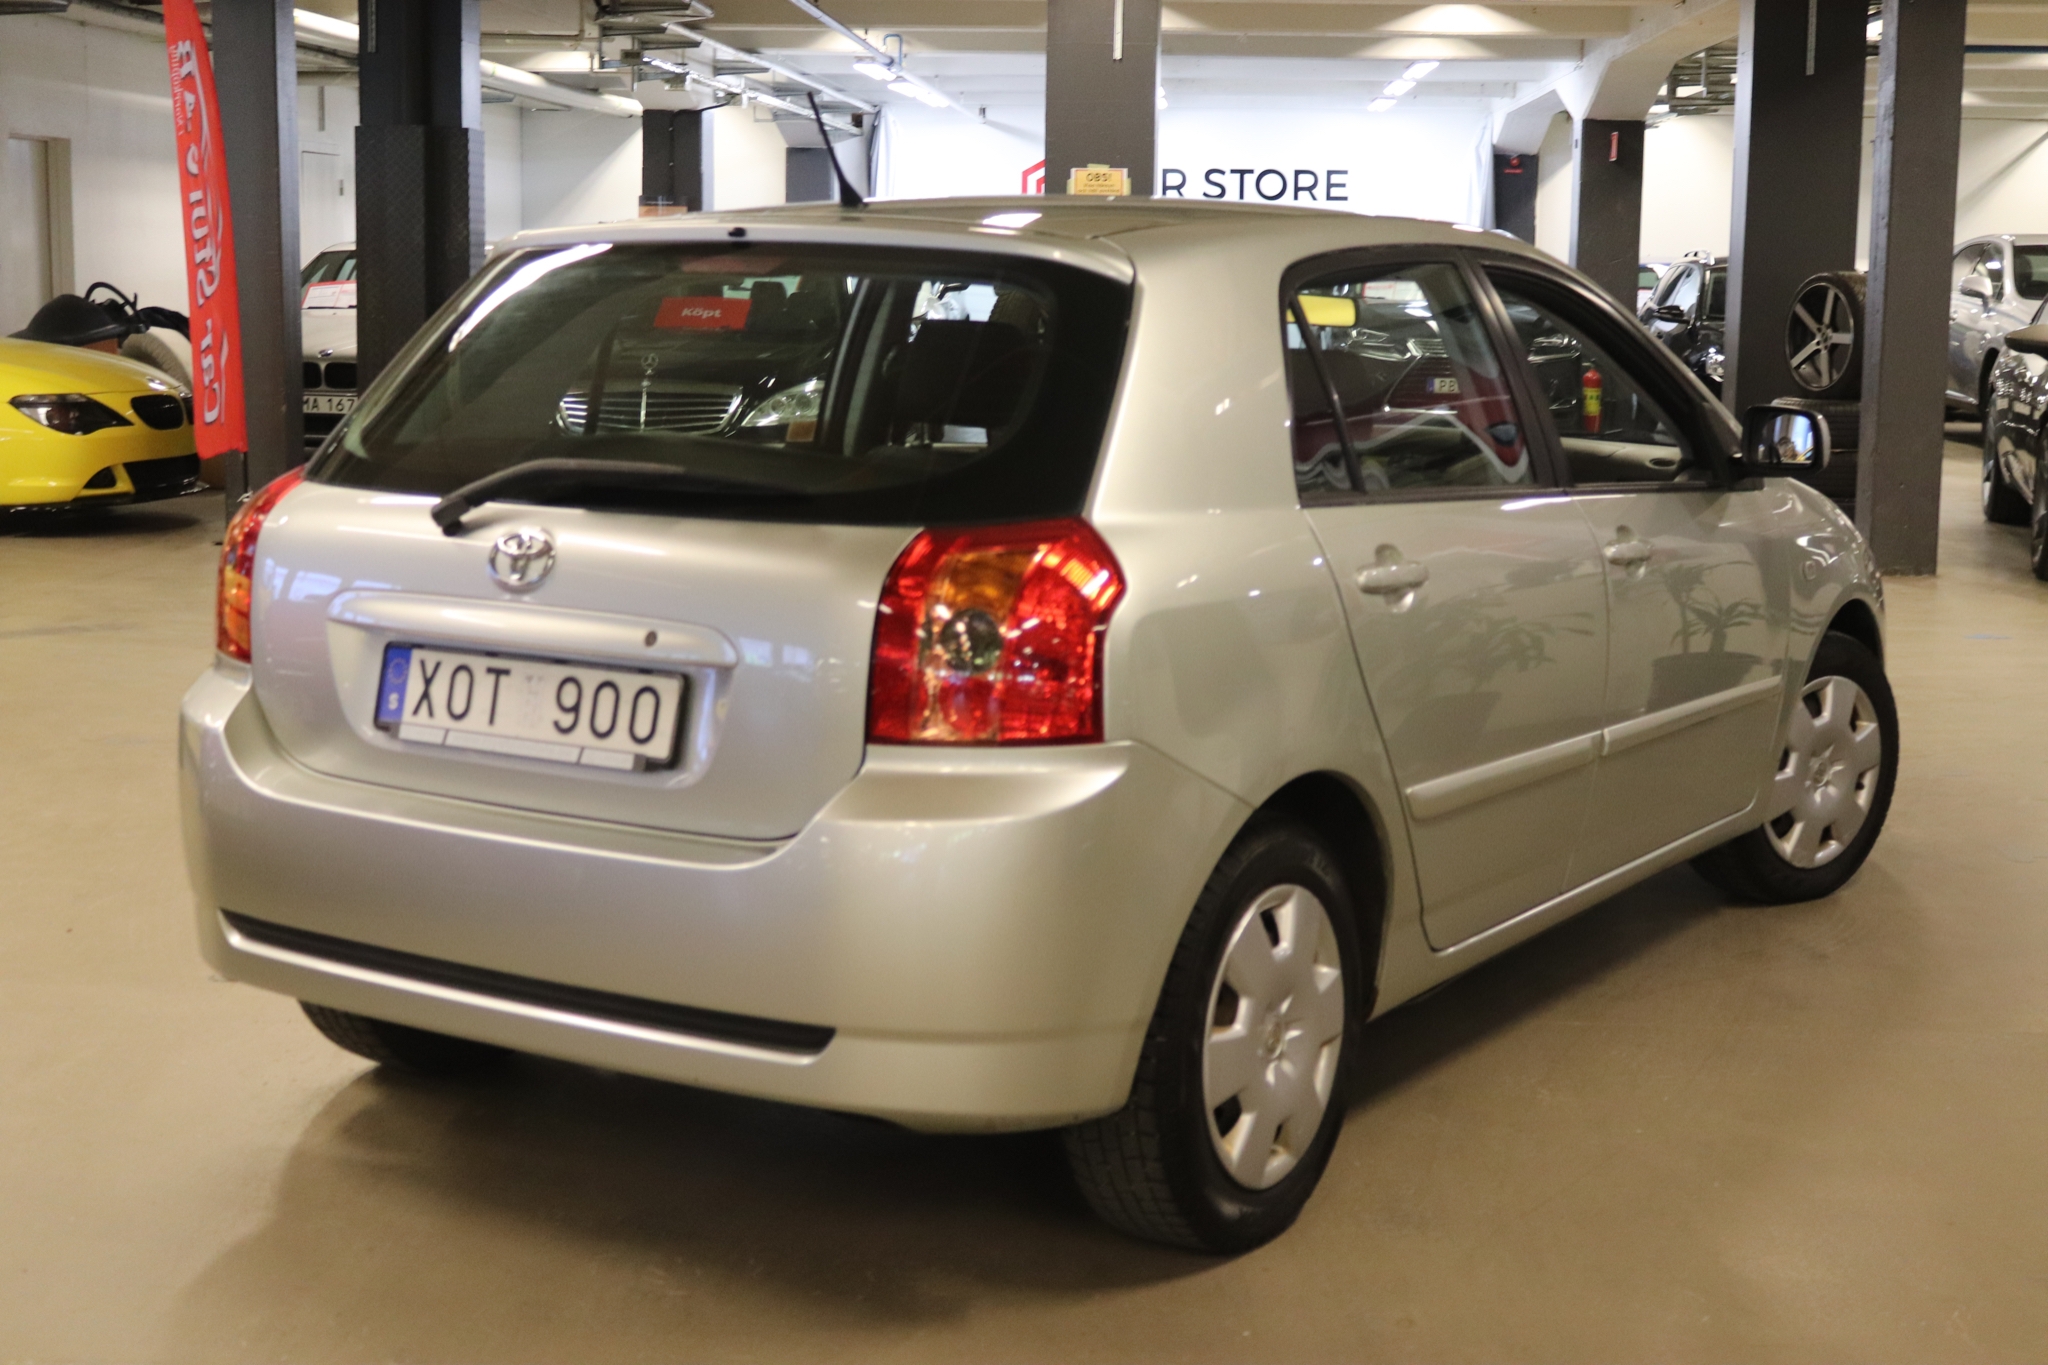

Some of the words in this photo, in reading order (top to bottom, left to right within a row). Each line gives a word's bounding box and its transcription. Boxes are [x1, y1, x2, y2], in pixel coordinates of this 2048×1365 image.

[1202, 168, 1349, 201] STORE
[681, 307, 722, 319] Köpt
[326, 397, 355, 412] 167
[387, 692, 399, 710] S
[412, 659, 511, 726] XOT
[553, 676, 661, 745] 900
